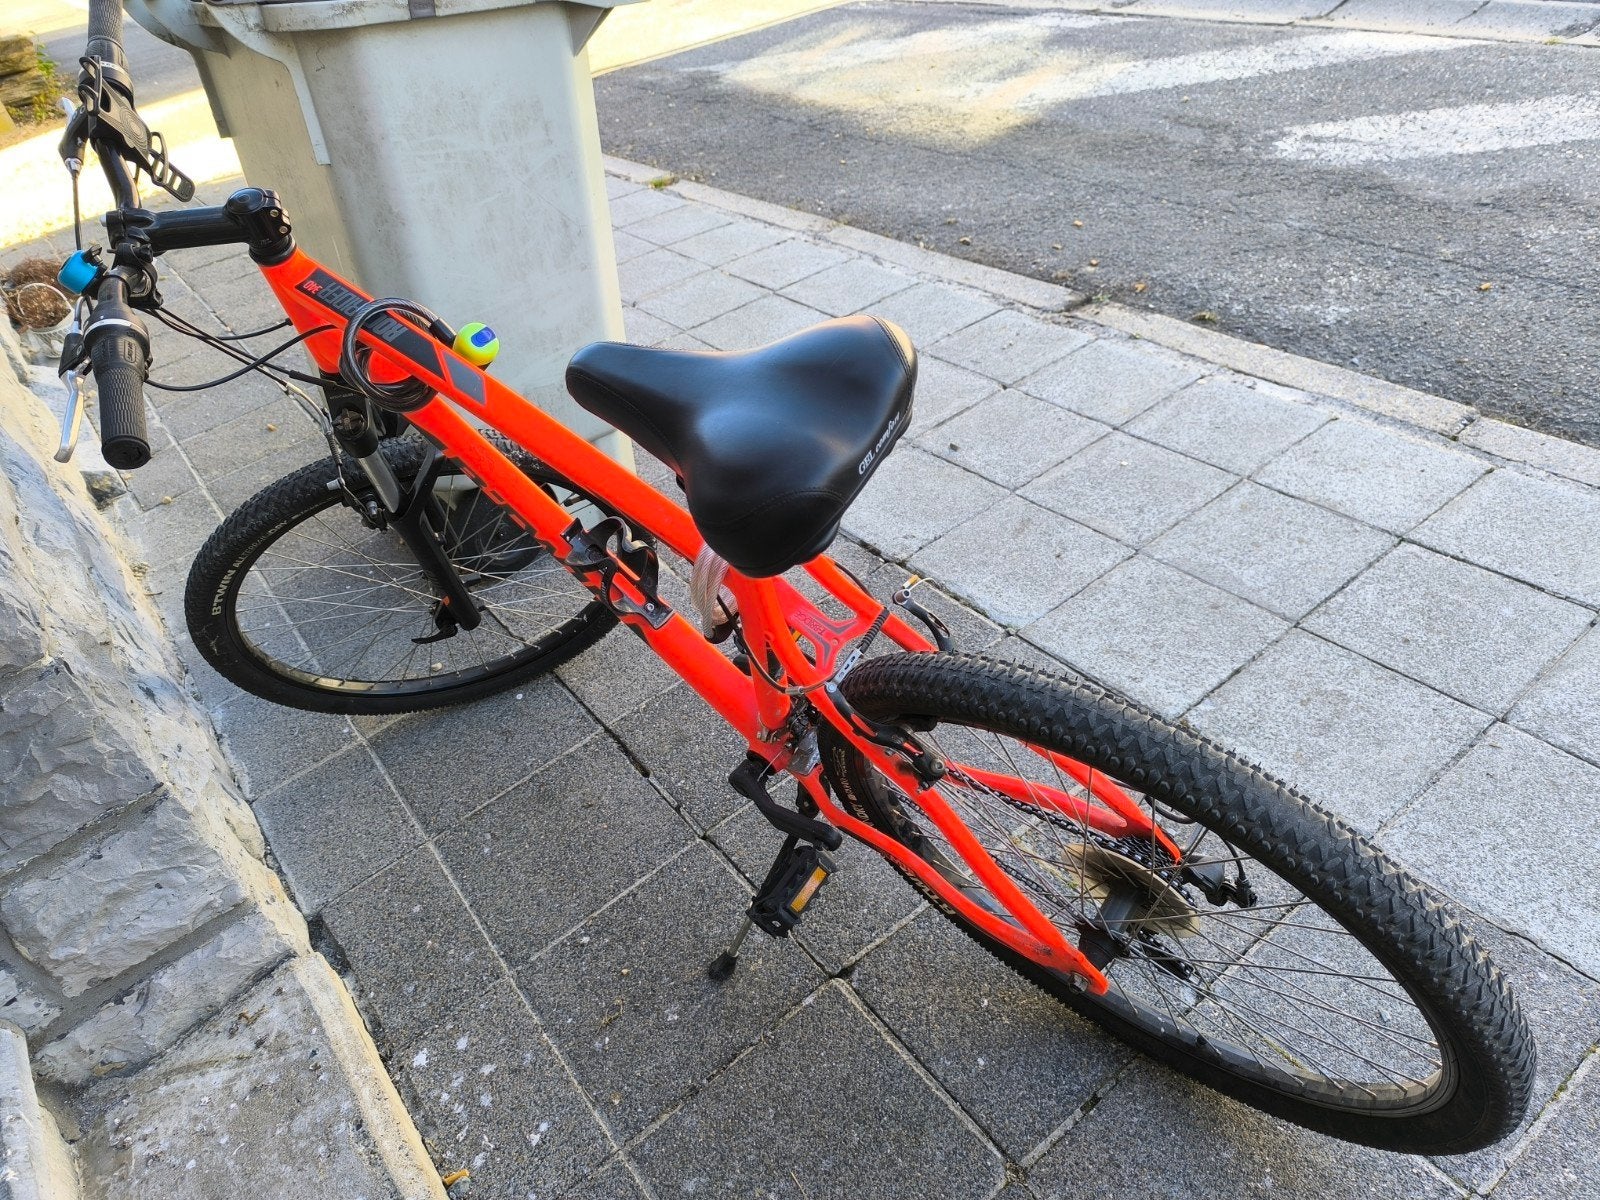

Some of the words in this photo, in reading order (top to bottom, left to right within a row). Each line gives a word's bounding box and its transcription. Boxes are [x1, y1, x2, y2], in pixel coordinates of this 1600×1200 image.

[302, 280, 323, 294] 340
[858, 449, 876, 475] GEL
[211, 569, 237, 616] B'TWIN
[795, 610, 826, 637] T-BRIDGE
